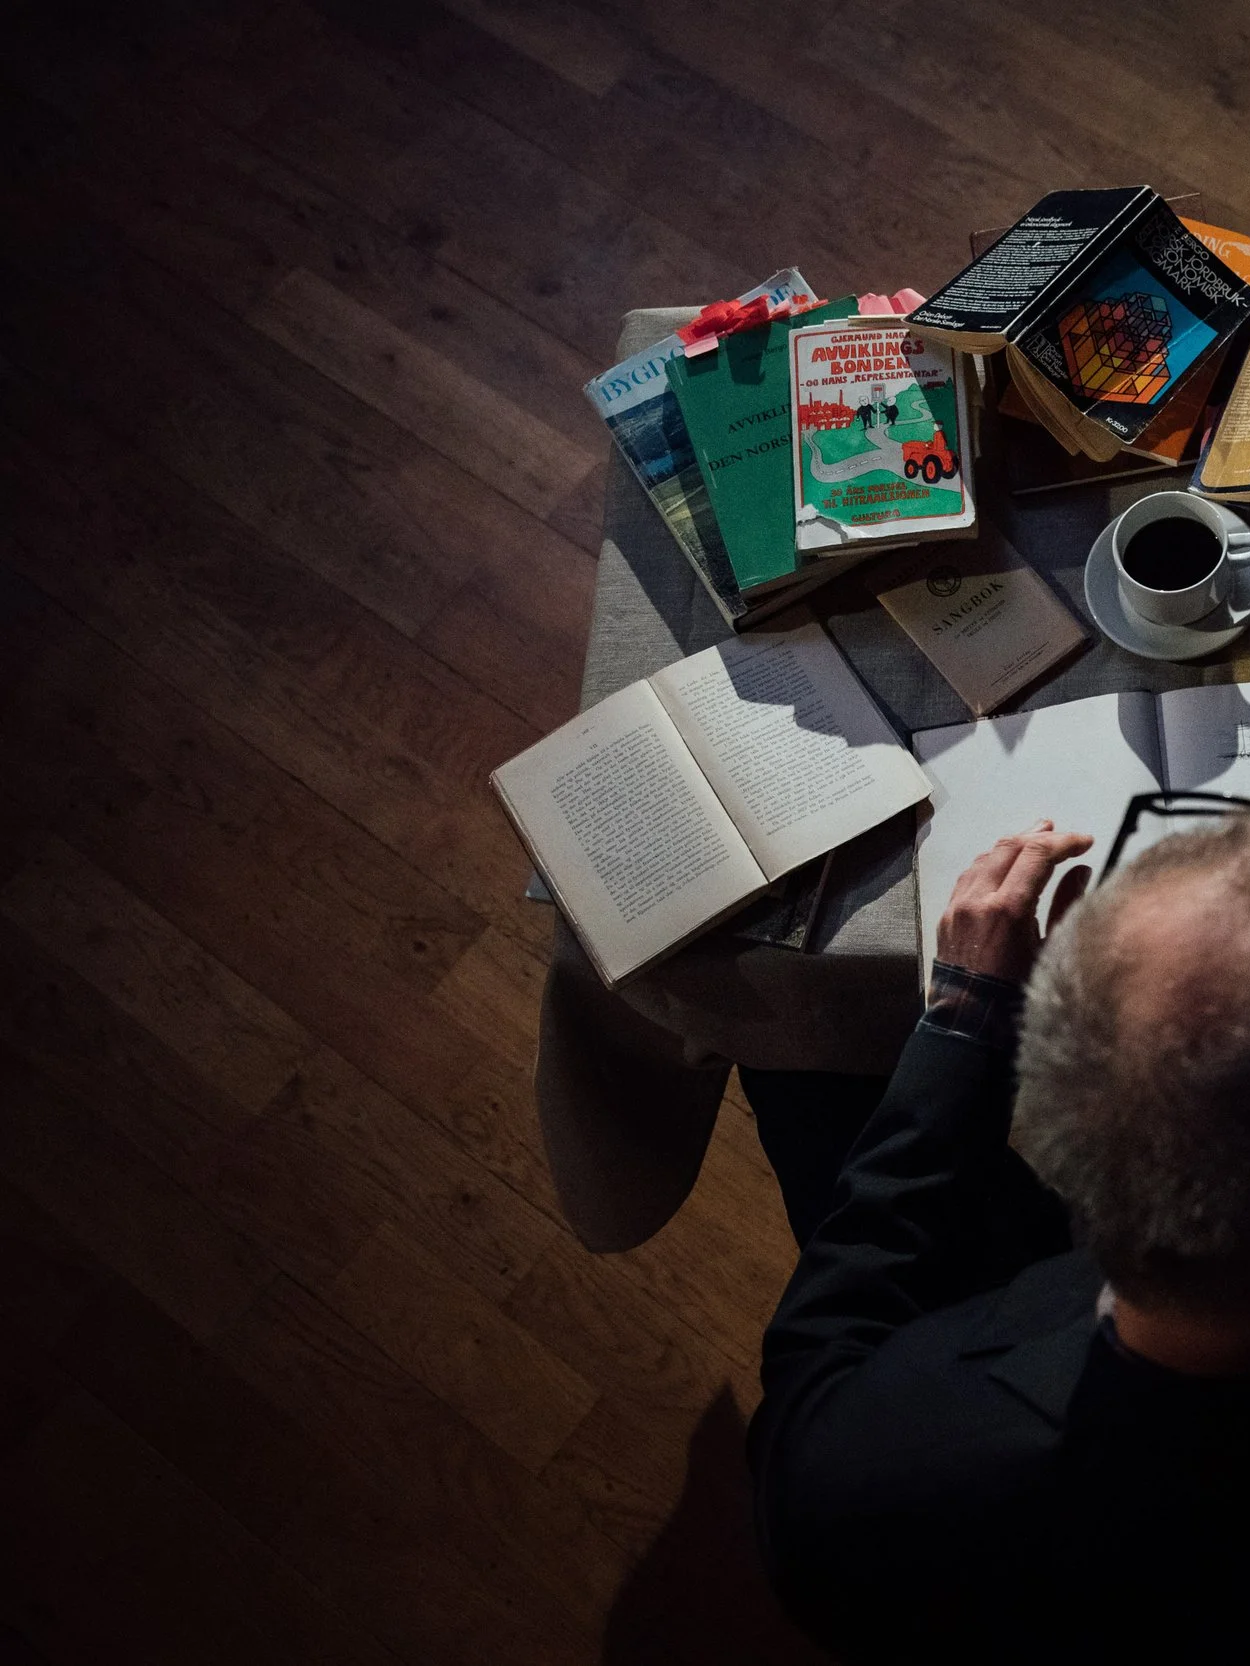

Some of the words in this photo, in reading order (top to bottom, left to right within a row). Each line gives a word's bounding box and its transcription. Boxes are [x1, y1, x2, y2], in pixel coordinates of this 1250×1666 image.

[831, 333, 883, 344] GJERMUND
[885, 331, 912, 340] HAGA
[830, 356, 910, 375] BONDEN
[821, 376, 848, 385] HANS
[708, 452, 744, 472] DEN
[932, 579, 1003, 635] SANGBOK
